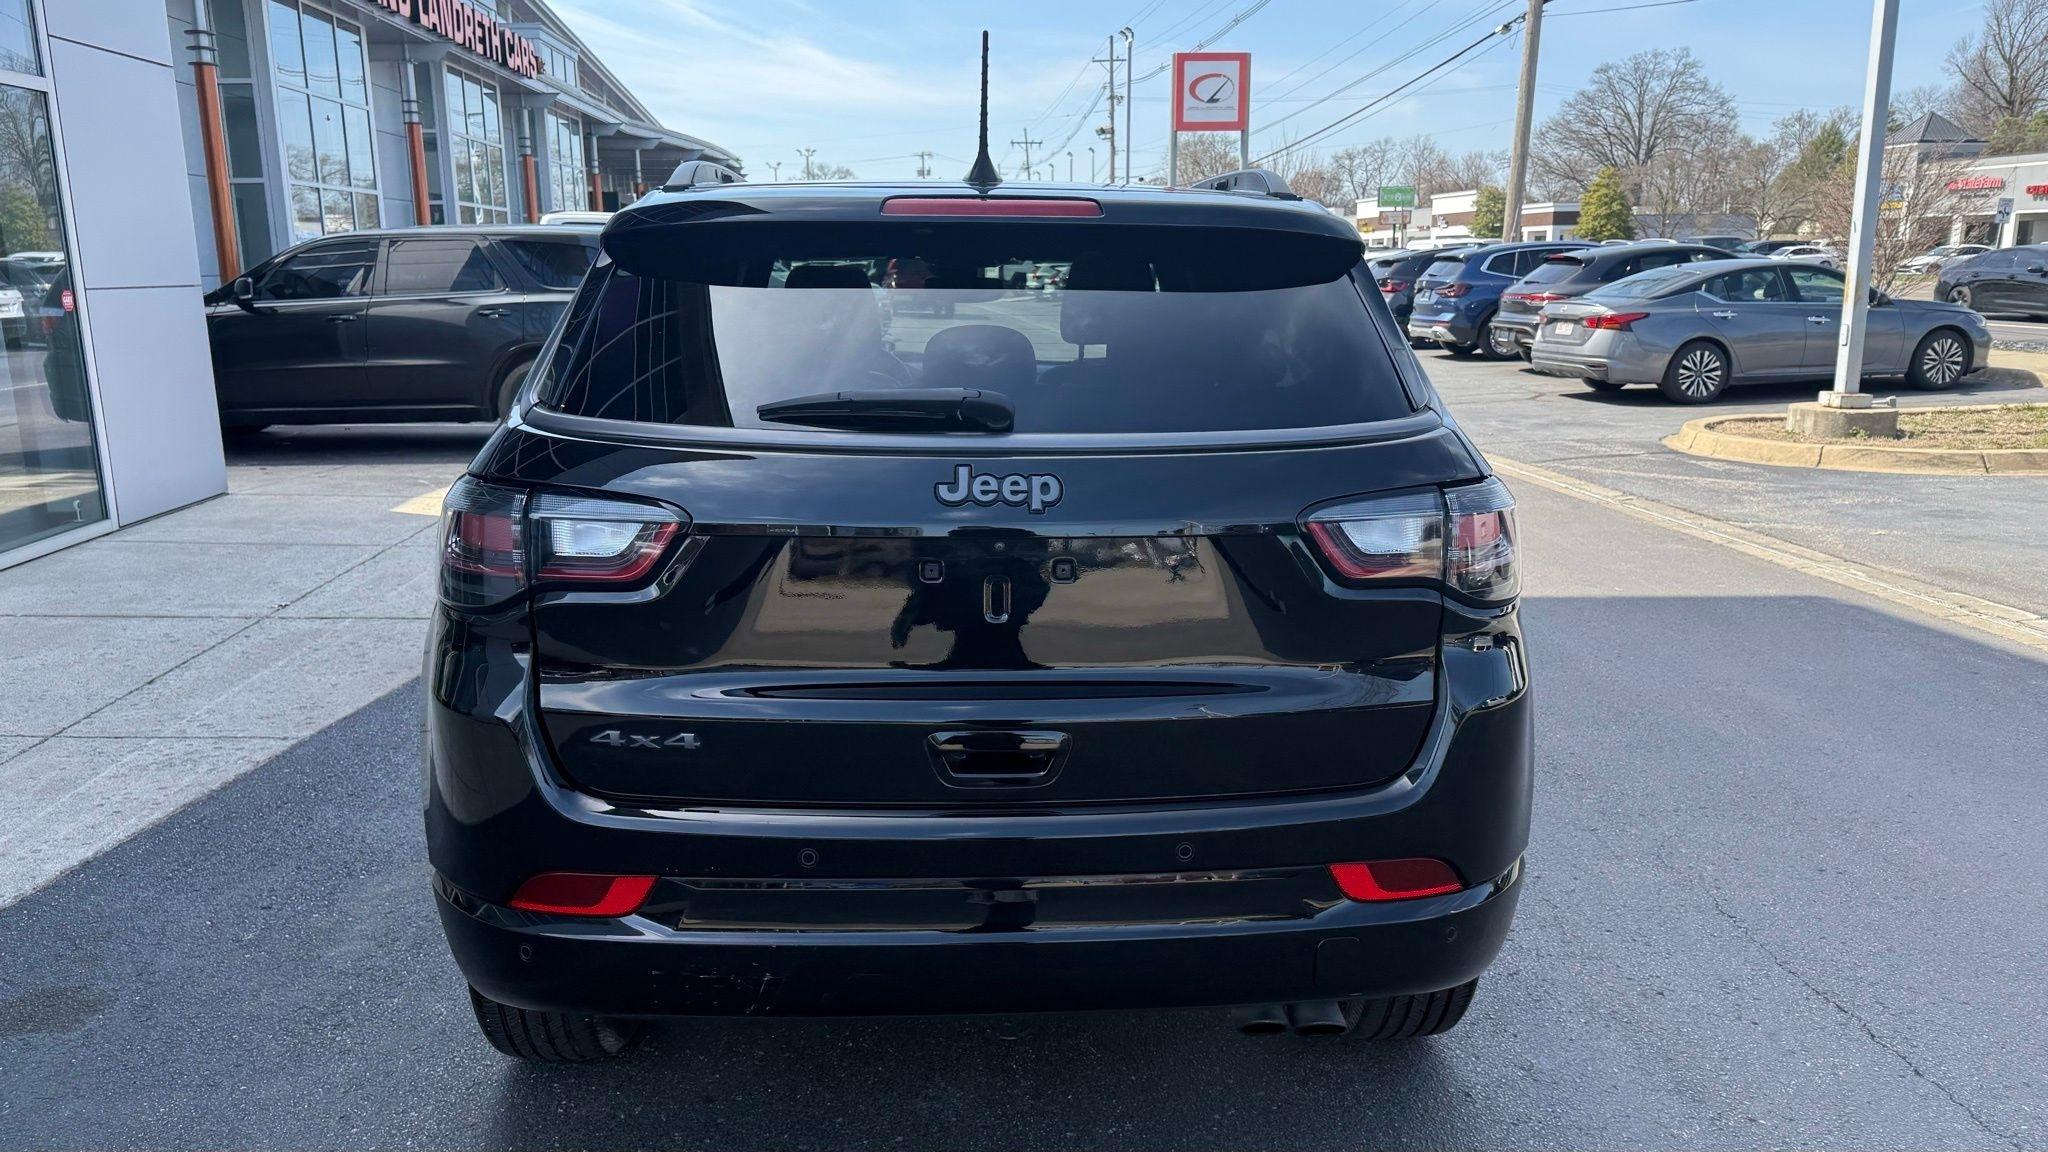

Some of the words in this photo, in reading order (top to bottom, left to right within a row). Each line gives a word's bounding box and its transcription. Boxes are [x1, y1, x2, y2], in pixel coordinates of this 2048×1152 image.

[418, 0, 502, 63] LANDRETH
[504, 28, 538, 79] CARS
[936, 464, 1063, 513] Jeep
[589, 730, 701, 750] 4x4
